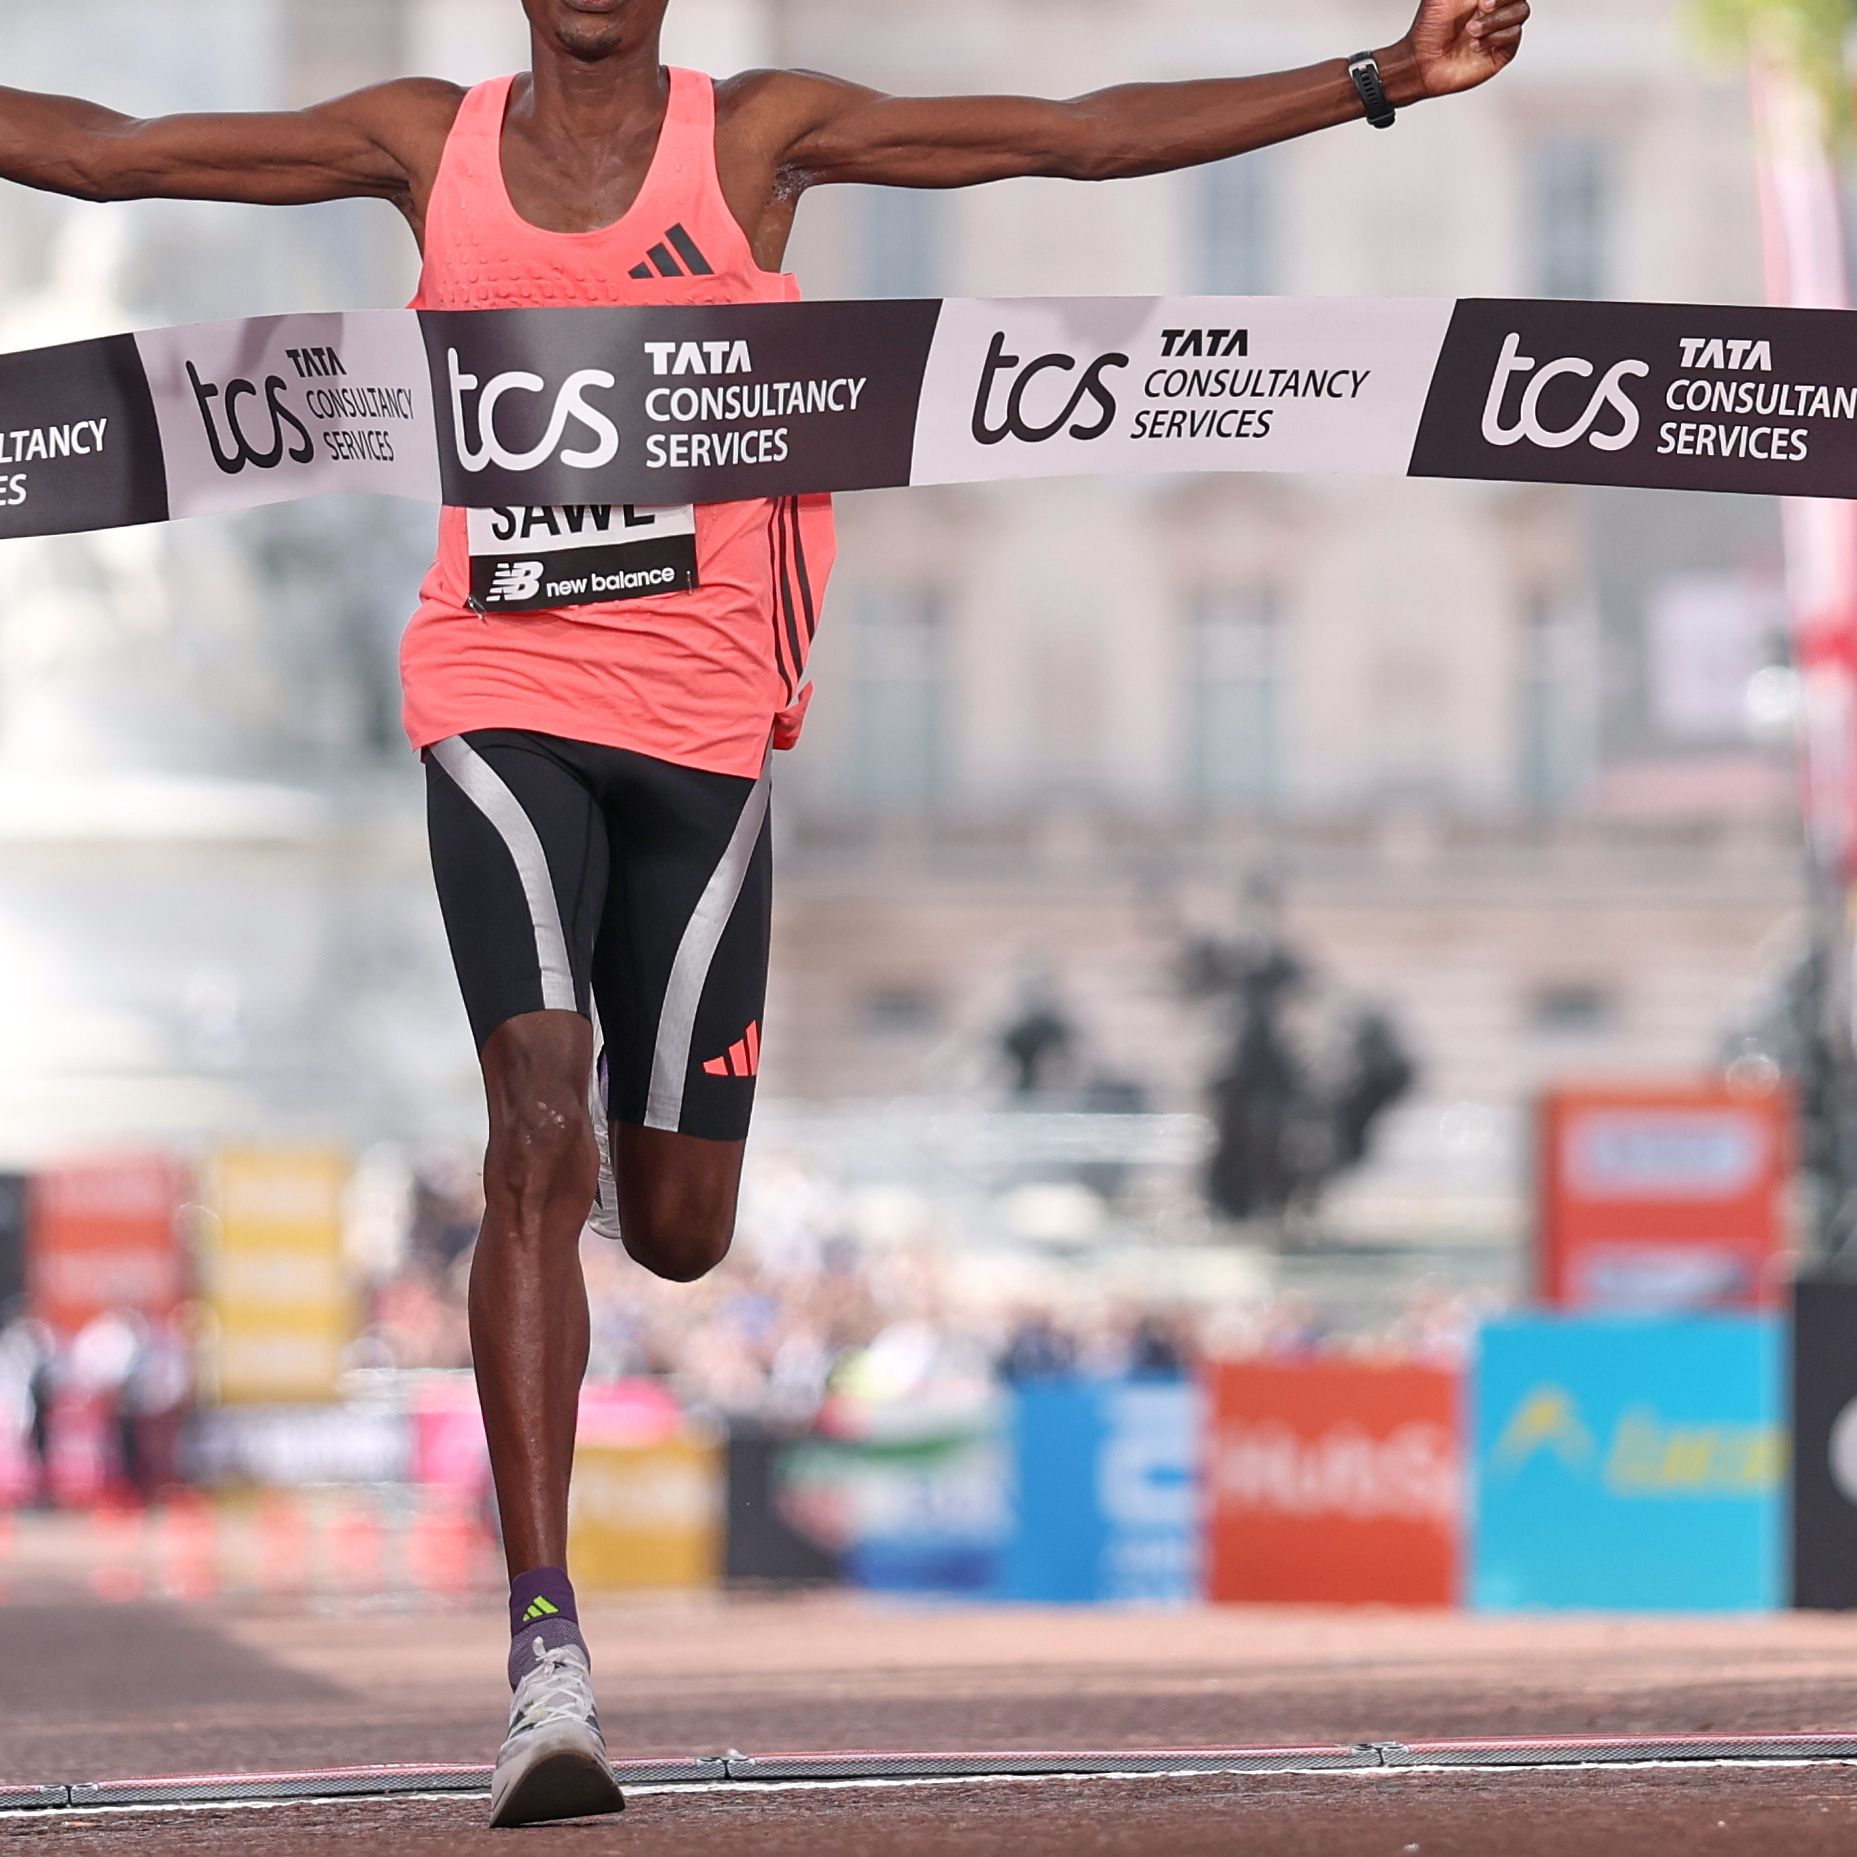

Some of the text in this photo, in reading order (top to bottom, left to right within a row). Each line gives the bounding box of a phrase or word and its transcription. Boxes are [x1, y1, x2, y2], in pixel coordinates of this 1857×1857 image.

[645, 340, 752, 375] TATA
[1159, 329, 1249, 357] TATA
[1677, 337, 1772, 372] TATA
[286, 347, 347, 377] TATA
[645, 377, 867, 423] CONSULTANCY
[971, 330, 1129, 446] tcs
[1143, 367, 1371, 399] CONSULTANCY
[1481, 332, 1651, 452] tcs
[186, 359, 315, 475] tcs
[305, 386, 415, 423] CONSULTANCY
[447, 347, 619, 472] tcs
[1129, 409, 1272, 441] SERVICES
[1656, 422, 1808, 461] SERVICES
[323, 430, 395, 463] SERVICES
[645, 428, 789, 468] SERVICES
[546, 566, 675, 598] new balance
